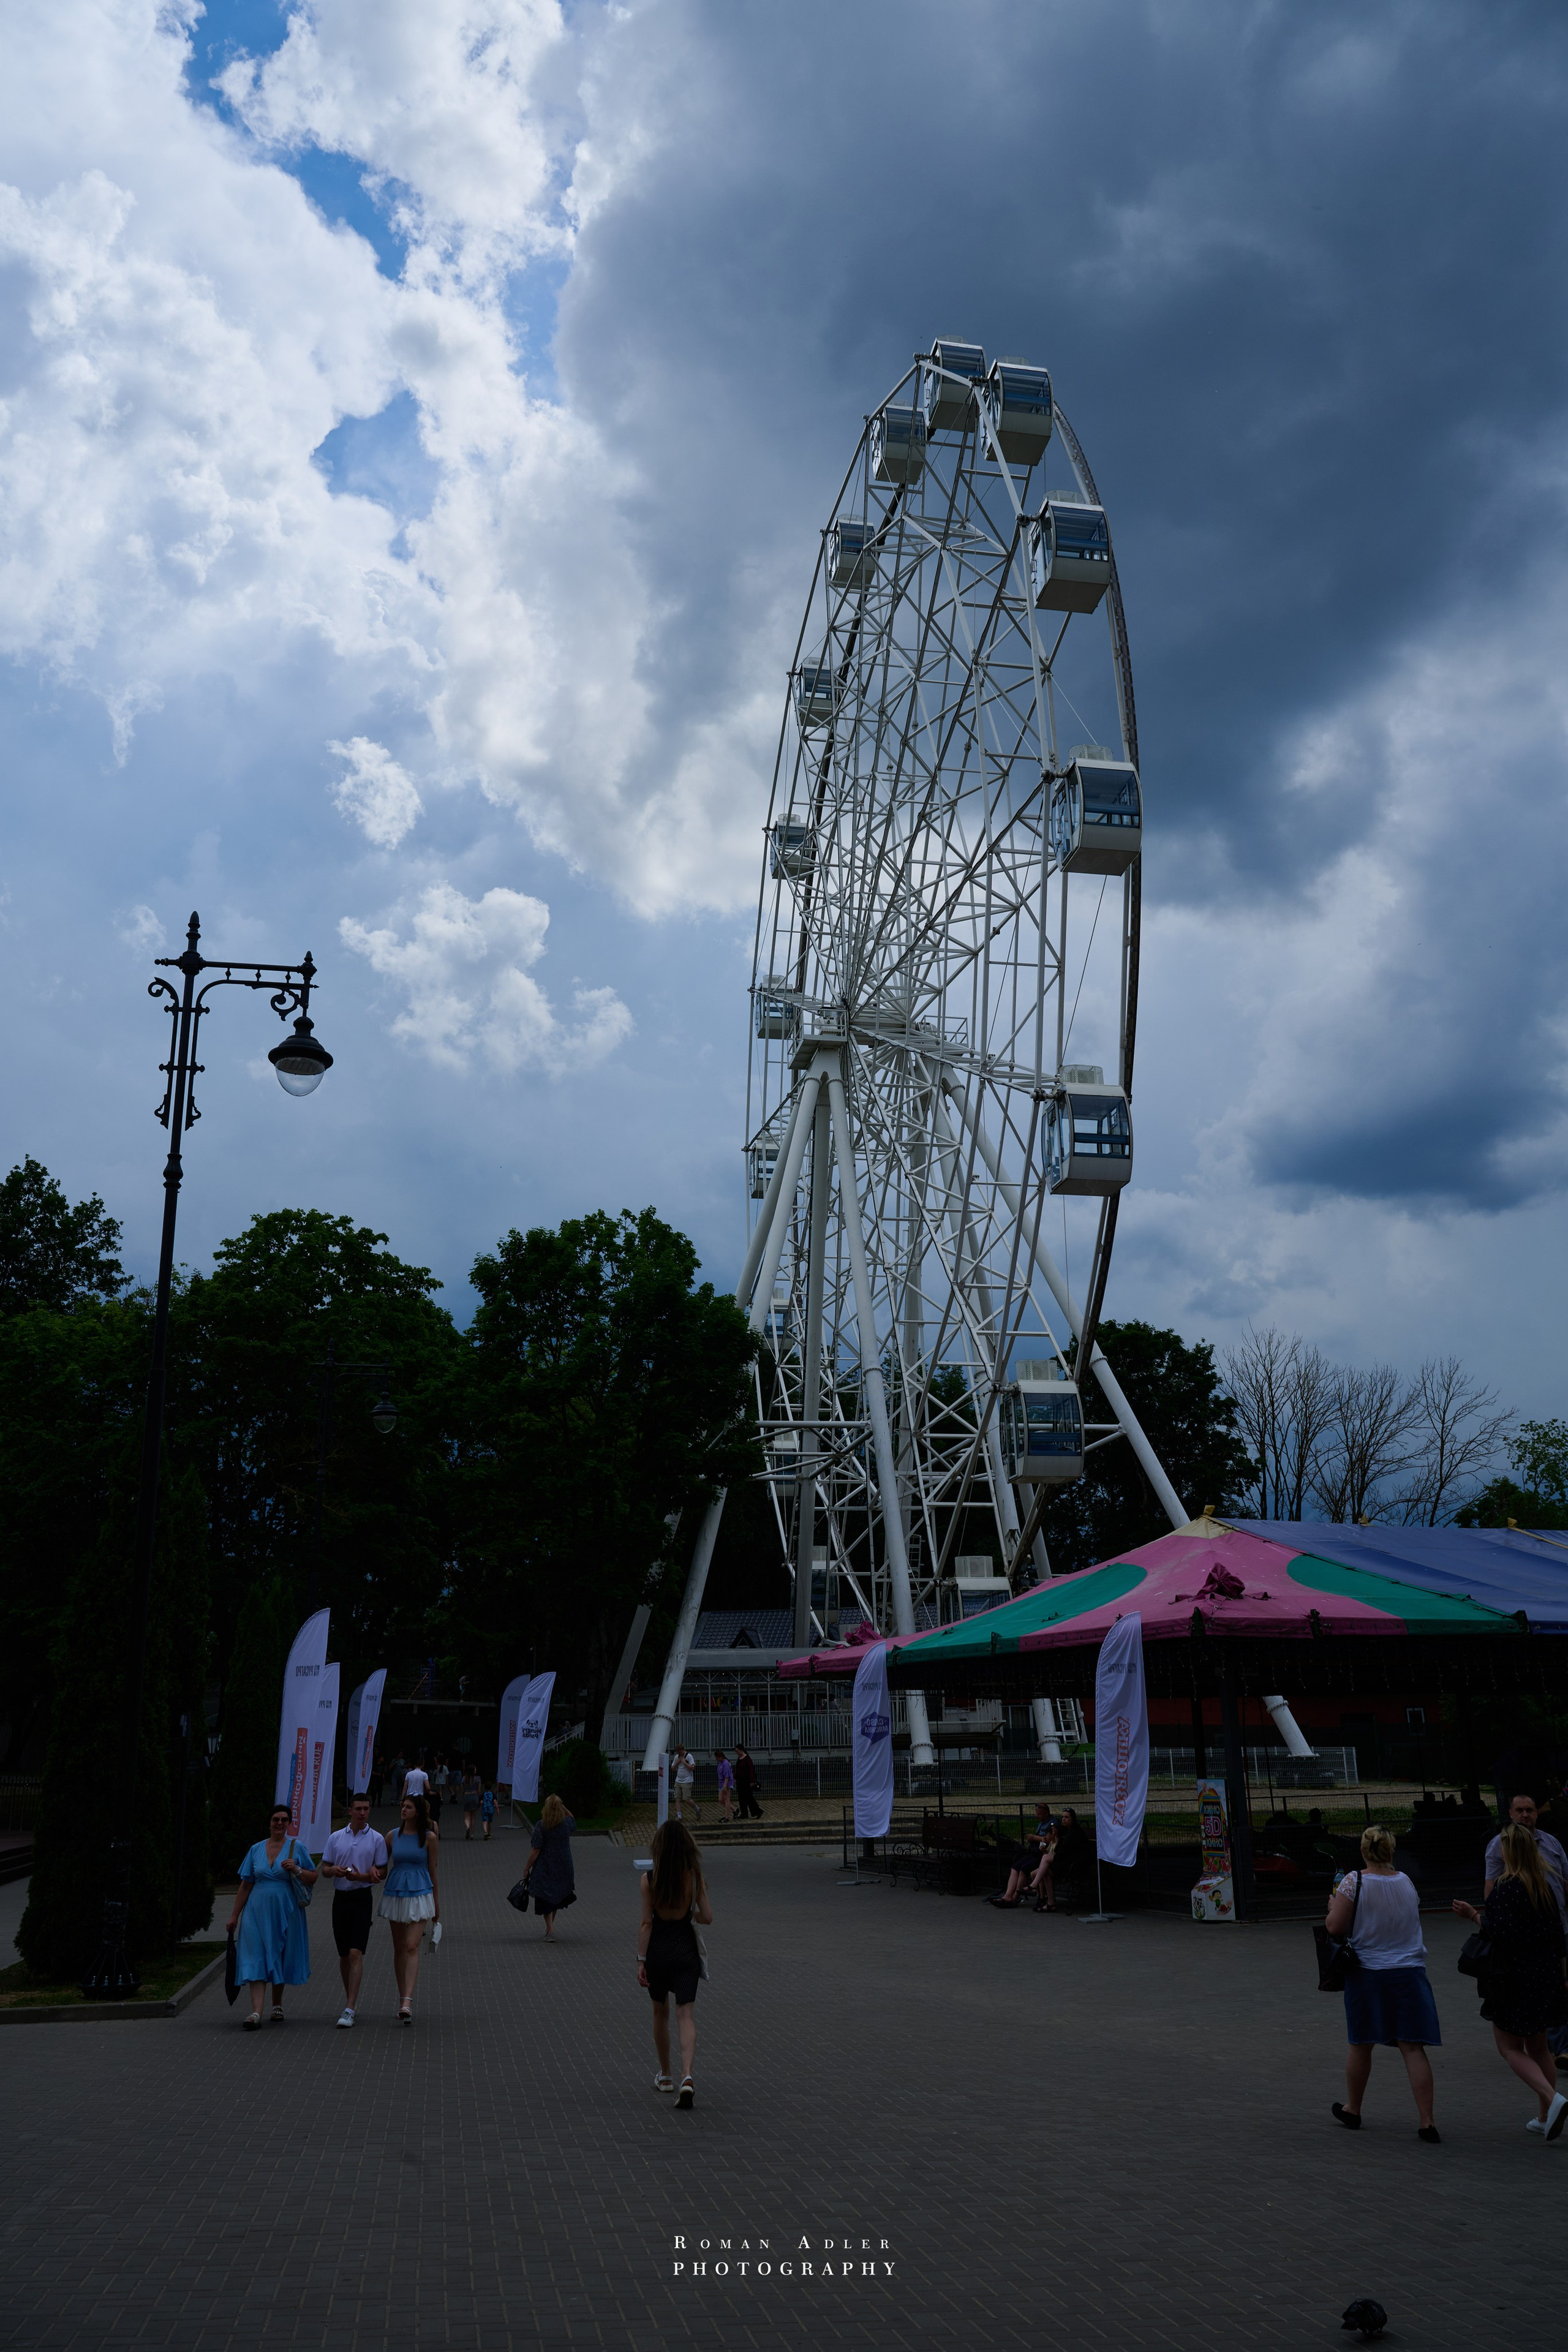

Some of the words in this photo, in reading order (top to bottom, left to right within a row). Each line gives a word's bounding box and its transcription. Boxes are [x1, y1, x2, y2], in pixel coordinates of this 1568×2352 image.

[1204, 1805, 1220, 1814] КИНО
[1204, 1816, 1222, 1836] 5D
[1206, 1838, 1223, 1848] КИНО
